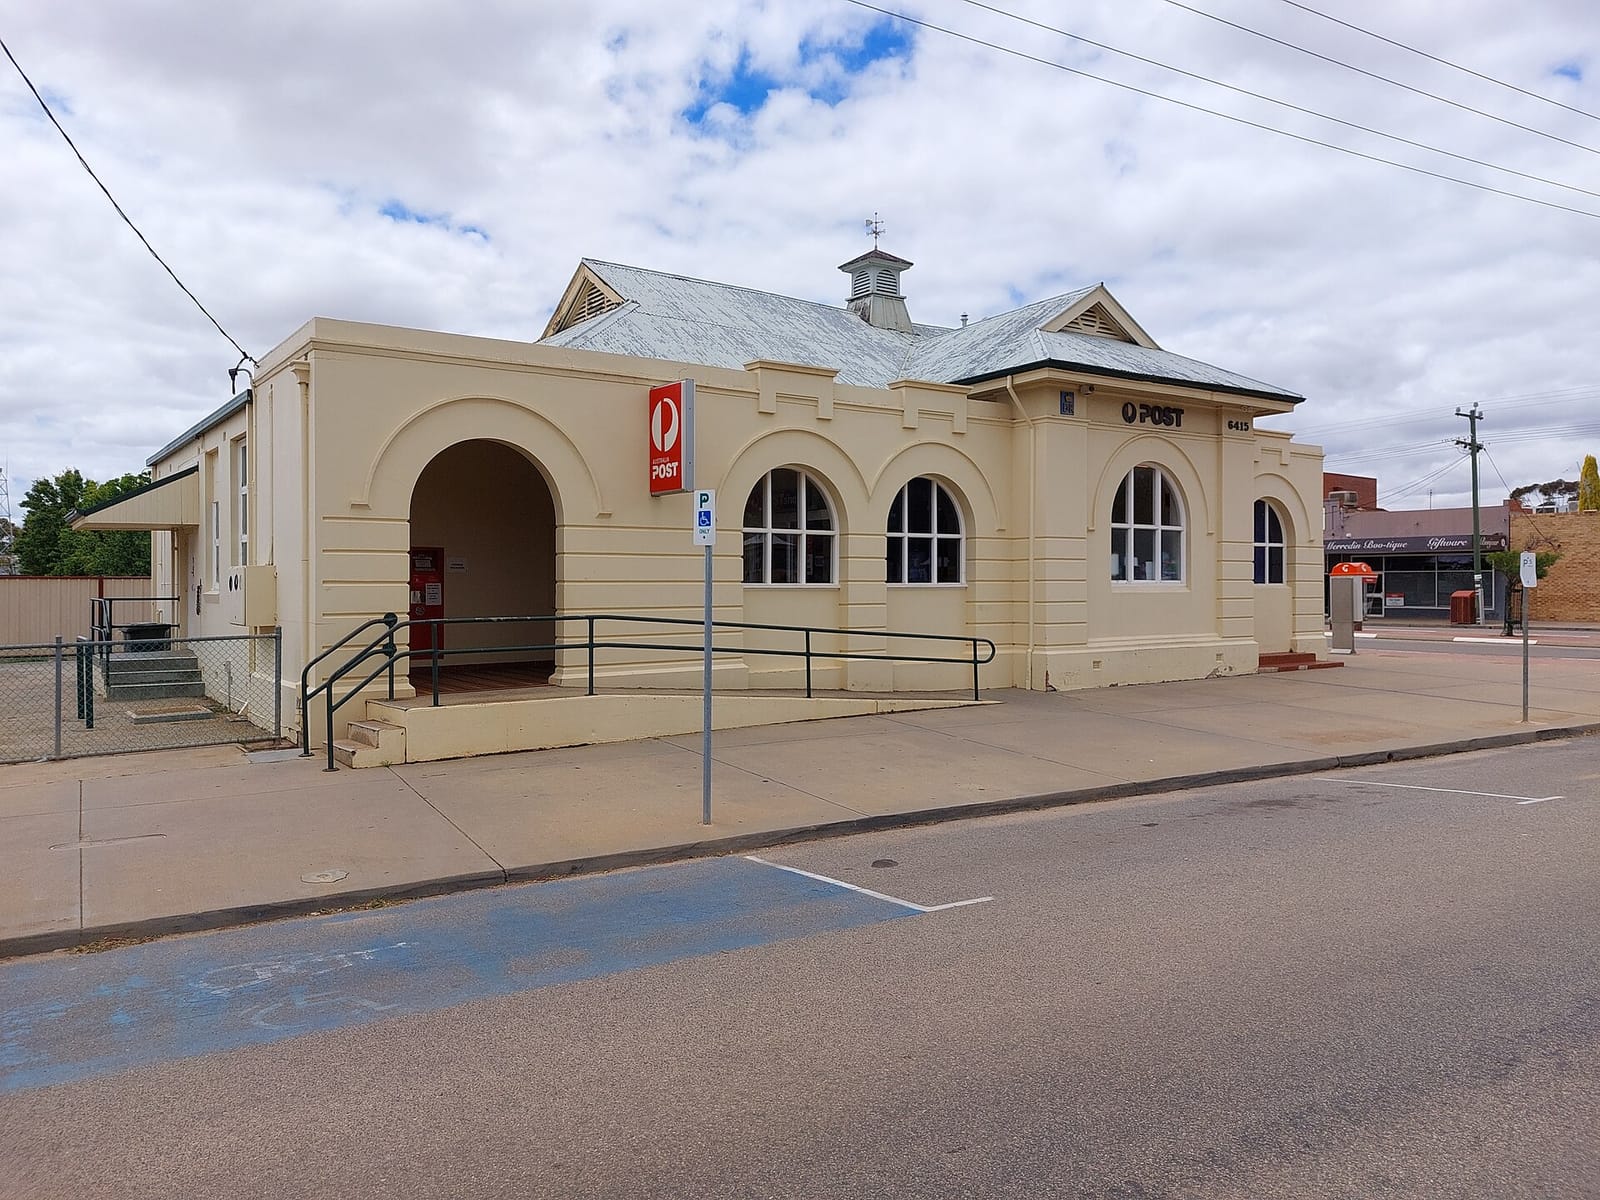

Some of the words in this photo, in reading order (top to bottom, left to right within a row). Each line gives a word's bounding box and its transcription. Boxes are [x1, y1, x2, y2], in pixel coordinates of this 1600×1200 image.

[1139, 403, 1184, 427] POST
[1227, 420, 1249, 431] 6415
[652, 462, 679, 480] POST
[699, 493, 709, 508] P
[1363, 540, 1408, 551] Boo-tique
[1427, 537, 1468, 549] Giftware
